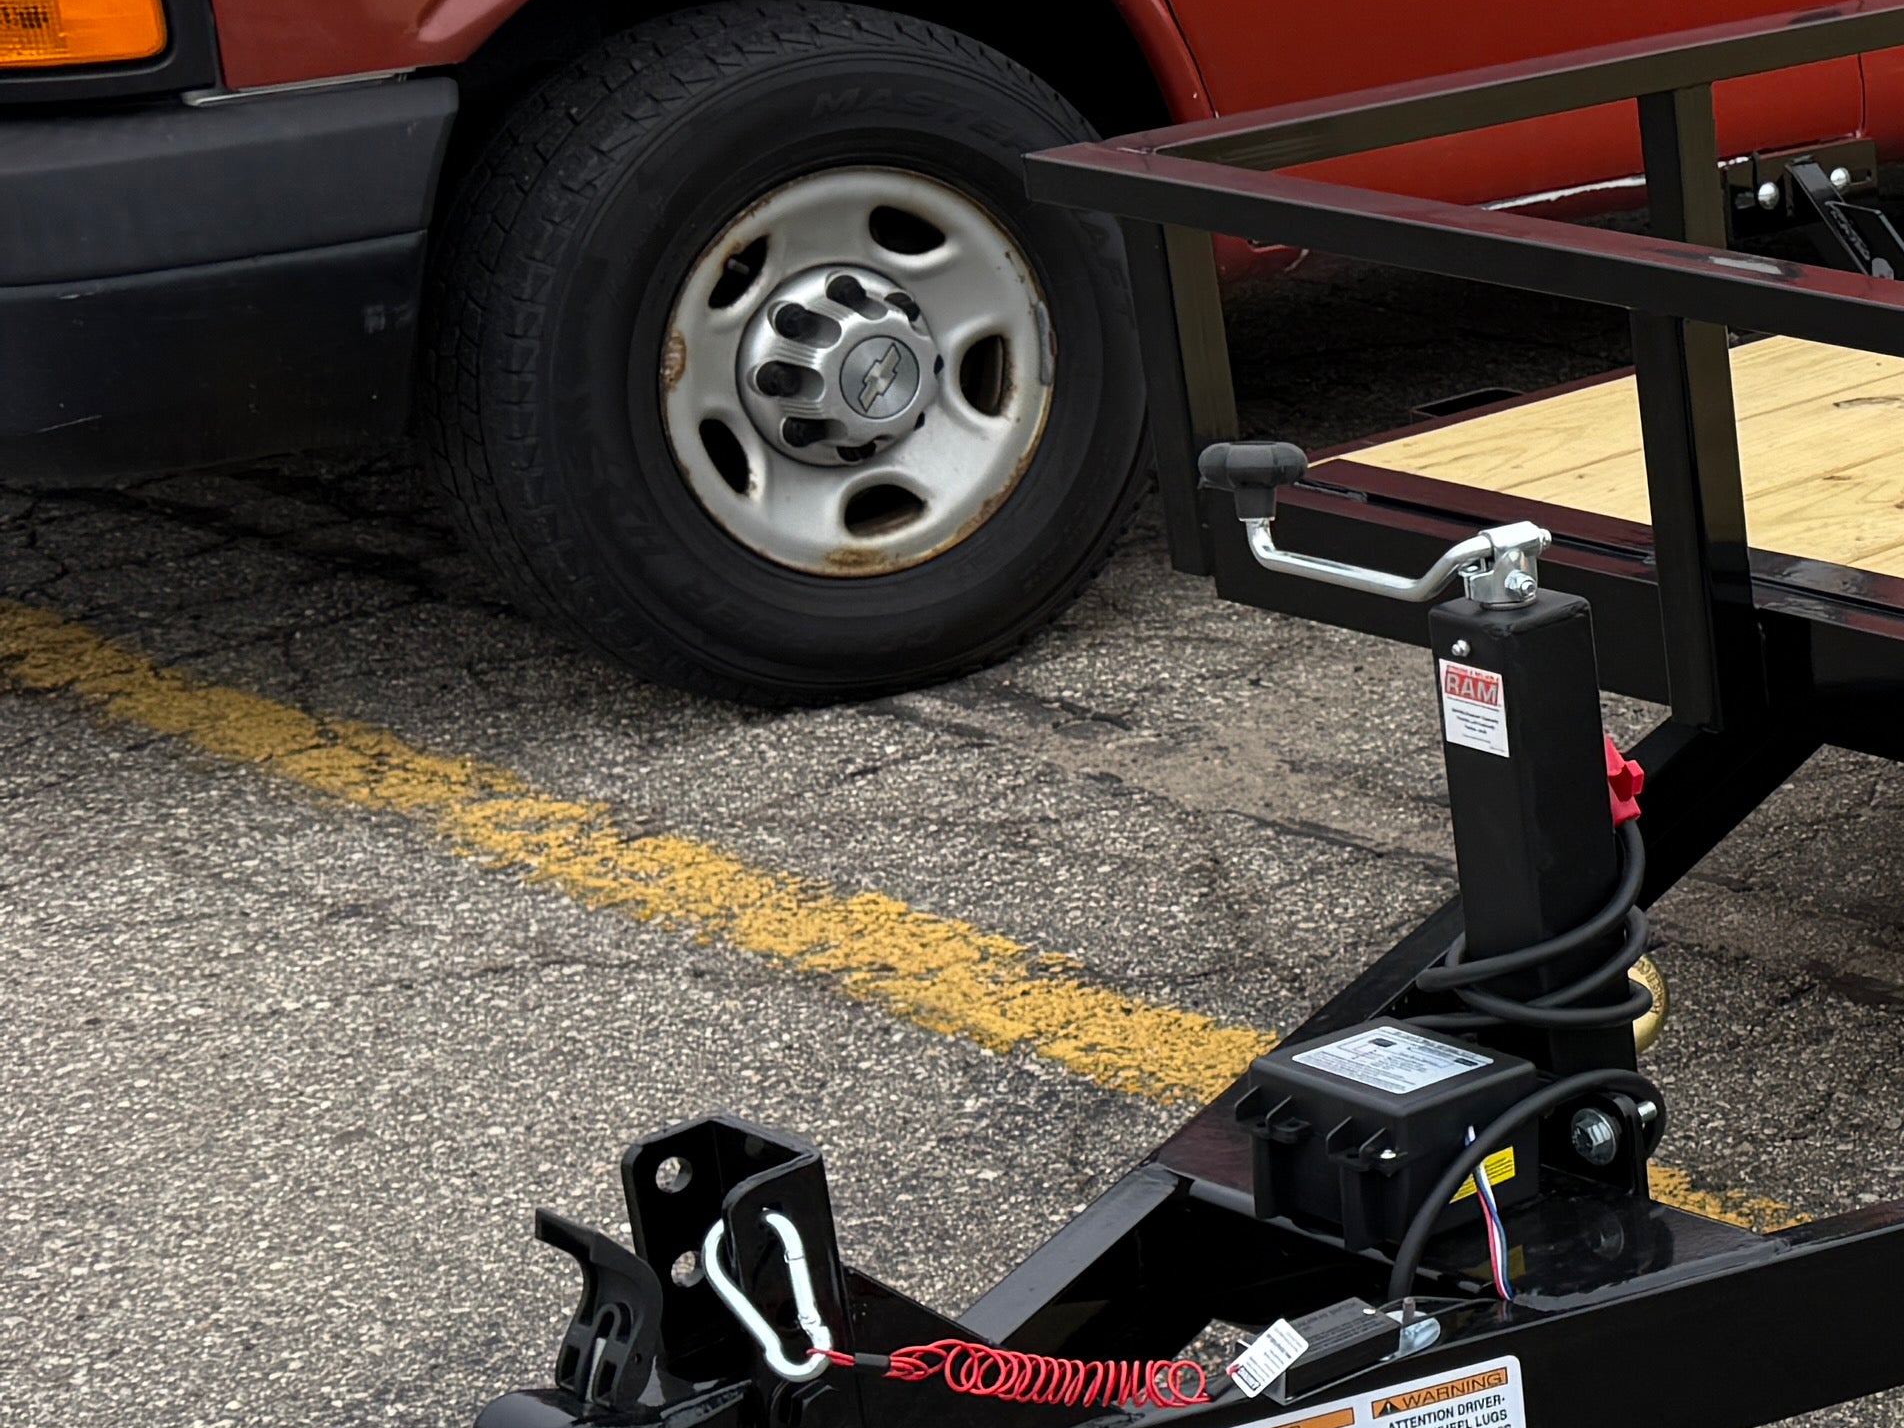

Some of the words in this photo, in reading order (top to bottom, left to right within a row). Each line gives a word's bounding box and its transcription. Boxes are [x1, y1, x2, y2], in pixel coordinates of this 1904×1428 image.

[1447, 672, 1498, 704] RAM
[1402, 1372, 1502, 1409] WARNING
[1476, 1409, 1508, 1427] LUGS
